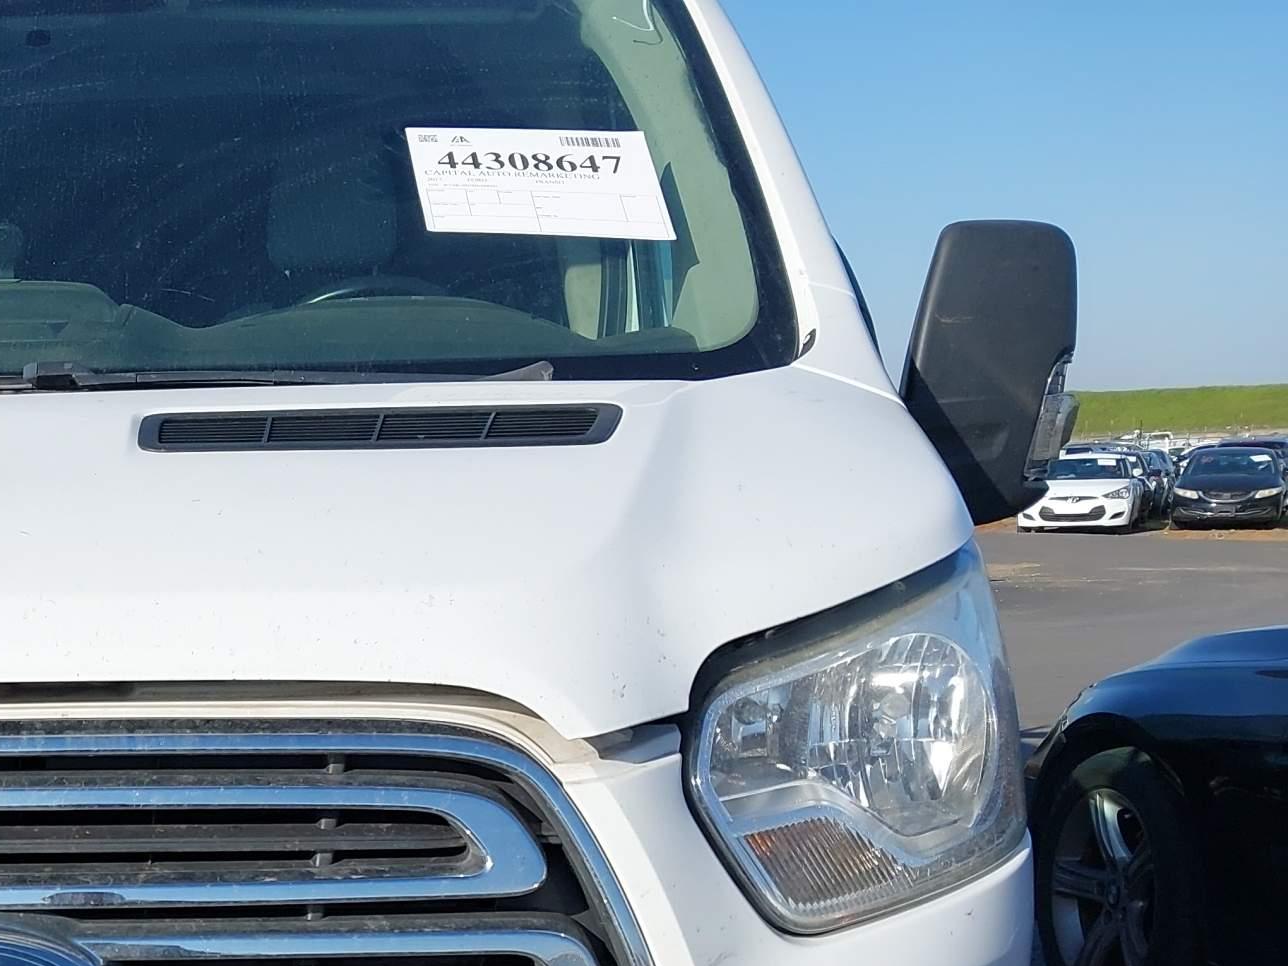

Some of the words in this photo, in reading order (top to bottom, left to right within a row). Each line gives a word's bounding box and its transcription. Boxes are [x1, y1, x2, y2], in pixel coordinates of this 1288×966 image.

[437, 151, 621, 174] 44308647
[424, 169, 476, 177] CAPITAL
[514, 171, 600, 180] REMARKETING
